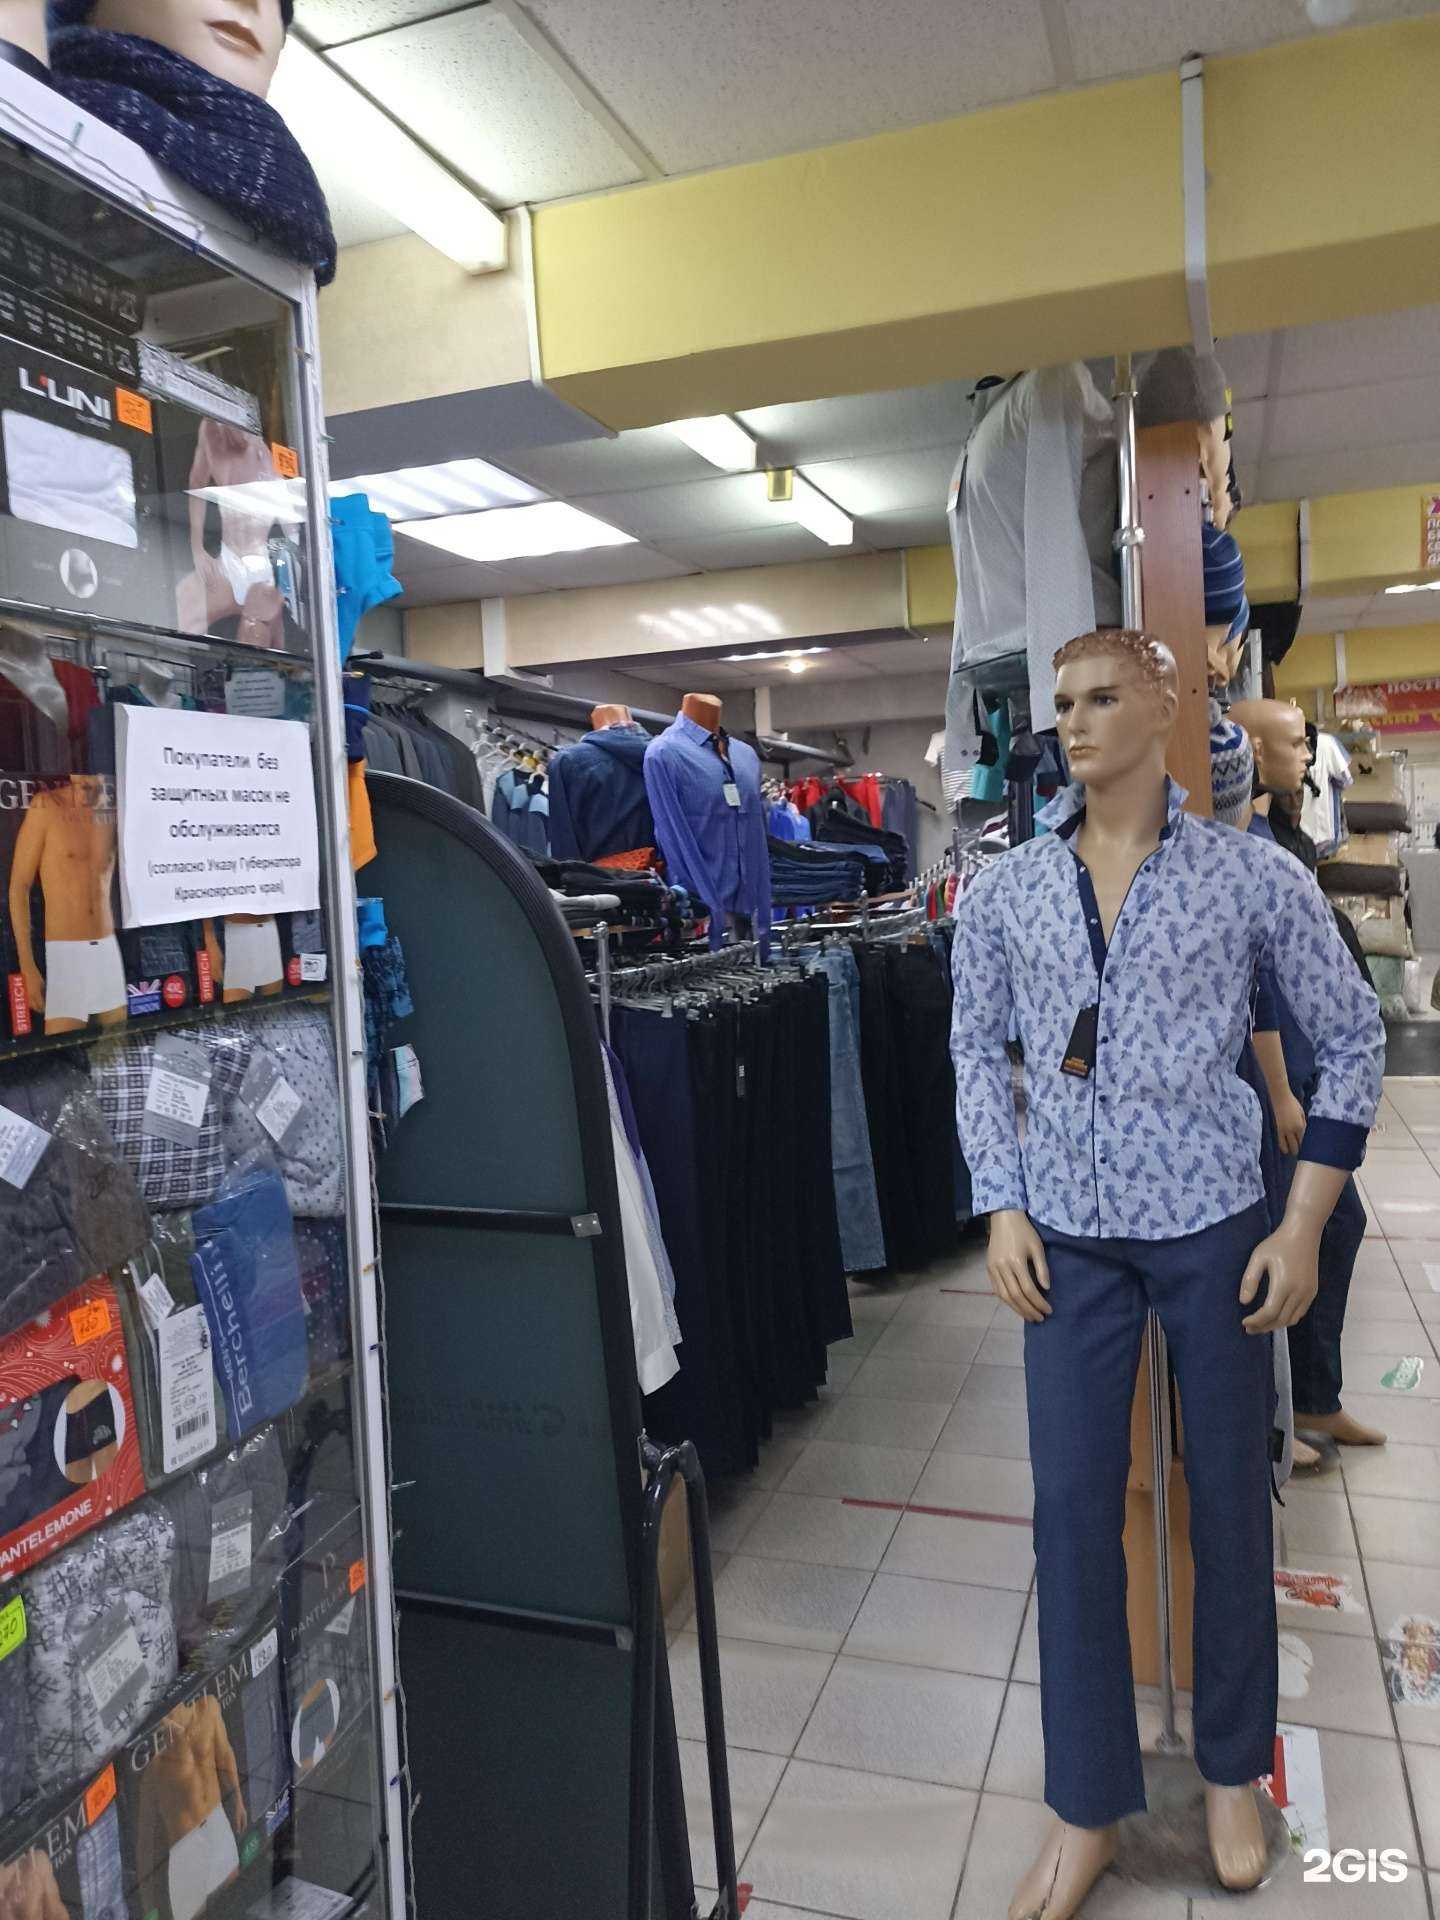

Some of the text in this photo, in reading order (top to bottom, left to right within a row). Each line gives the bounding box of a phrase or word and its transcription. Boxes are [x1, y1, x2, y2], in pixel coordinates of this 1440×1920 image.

[163, 746, 279, 770] Покупатели без
[150, 786, 290, 806] защитных масок не
[169, 819, 281, 841] обслуживаются
[148, 855, 301, 877] (согласно Указу Губернатора
[174, 879, 284, 902] Красноярского края)
[13, 974, 29, 1033] STRETCH
[209, 1260, 254, 1416] Berchelli
